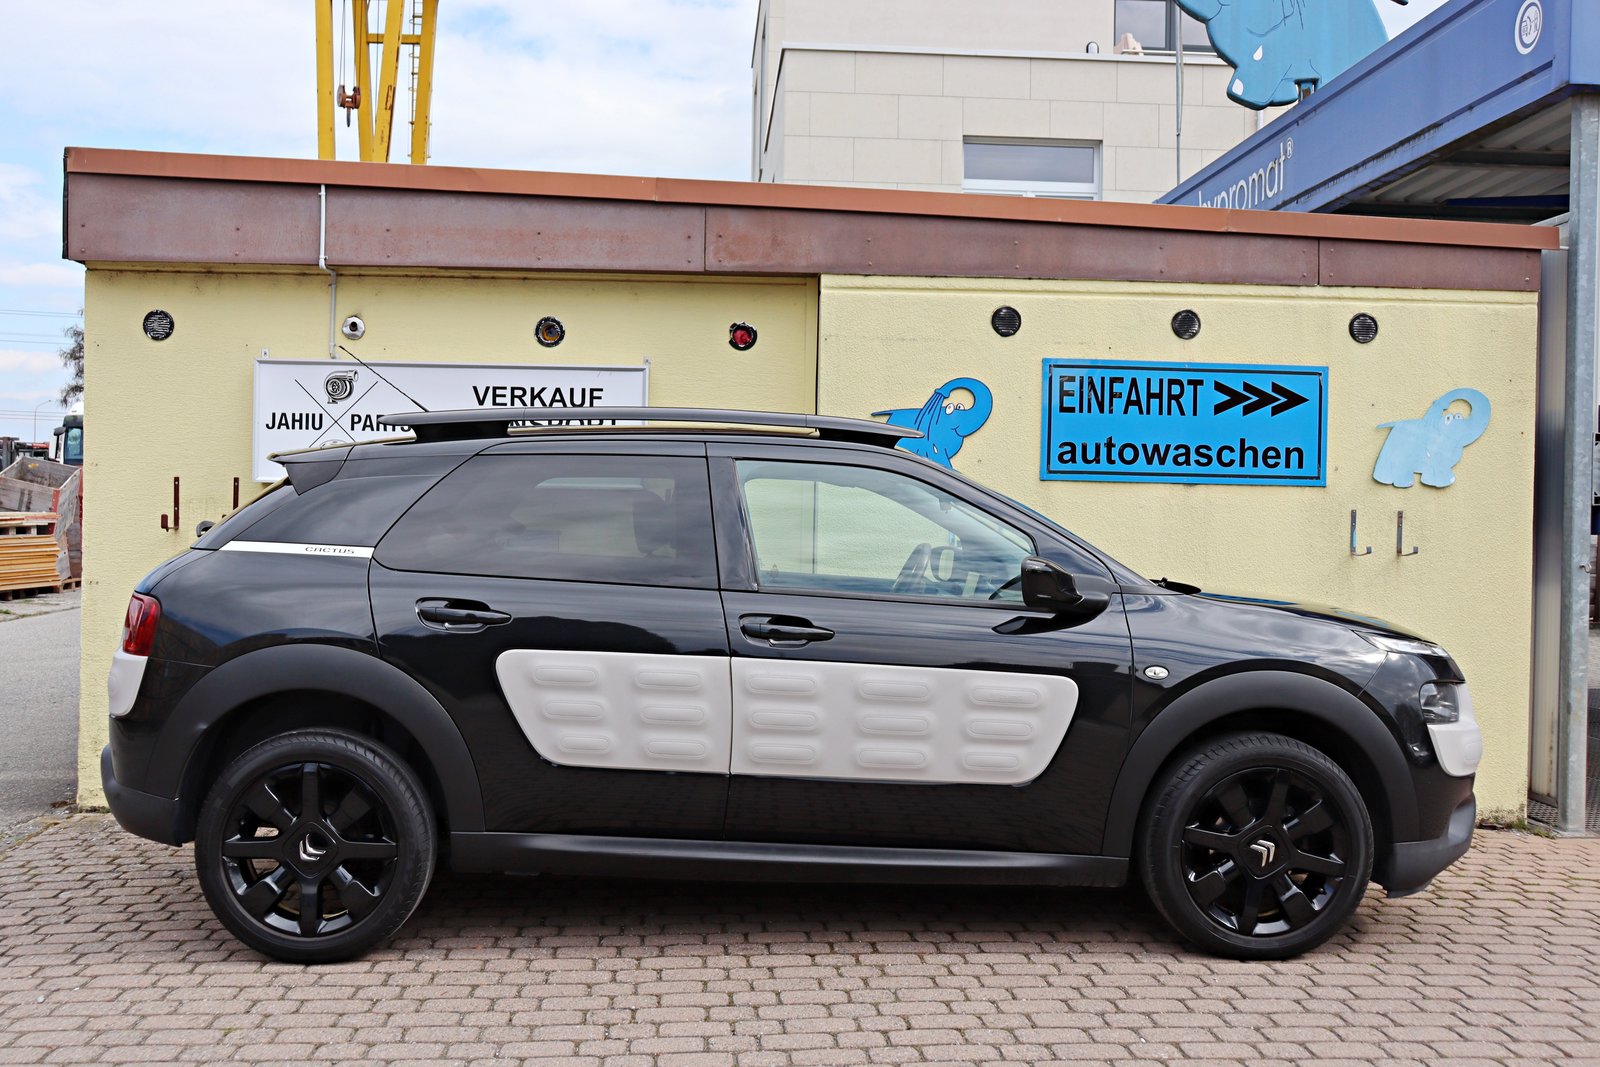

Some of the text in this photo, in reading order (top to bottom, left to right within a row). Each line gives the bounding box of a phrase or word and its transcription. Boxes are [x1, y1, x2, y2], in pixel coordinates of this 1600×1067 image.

[472, 385, 604, 407] VERKAUF
[1058, 375, 1204, 417] EINFAHRT
[266, 412, 323, 431] JAHIU
[1057, 436, 1304, 470] autowaschen
[305, 546, 355, 555] CACTUS
